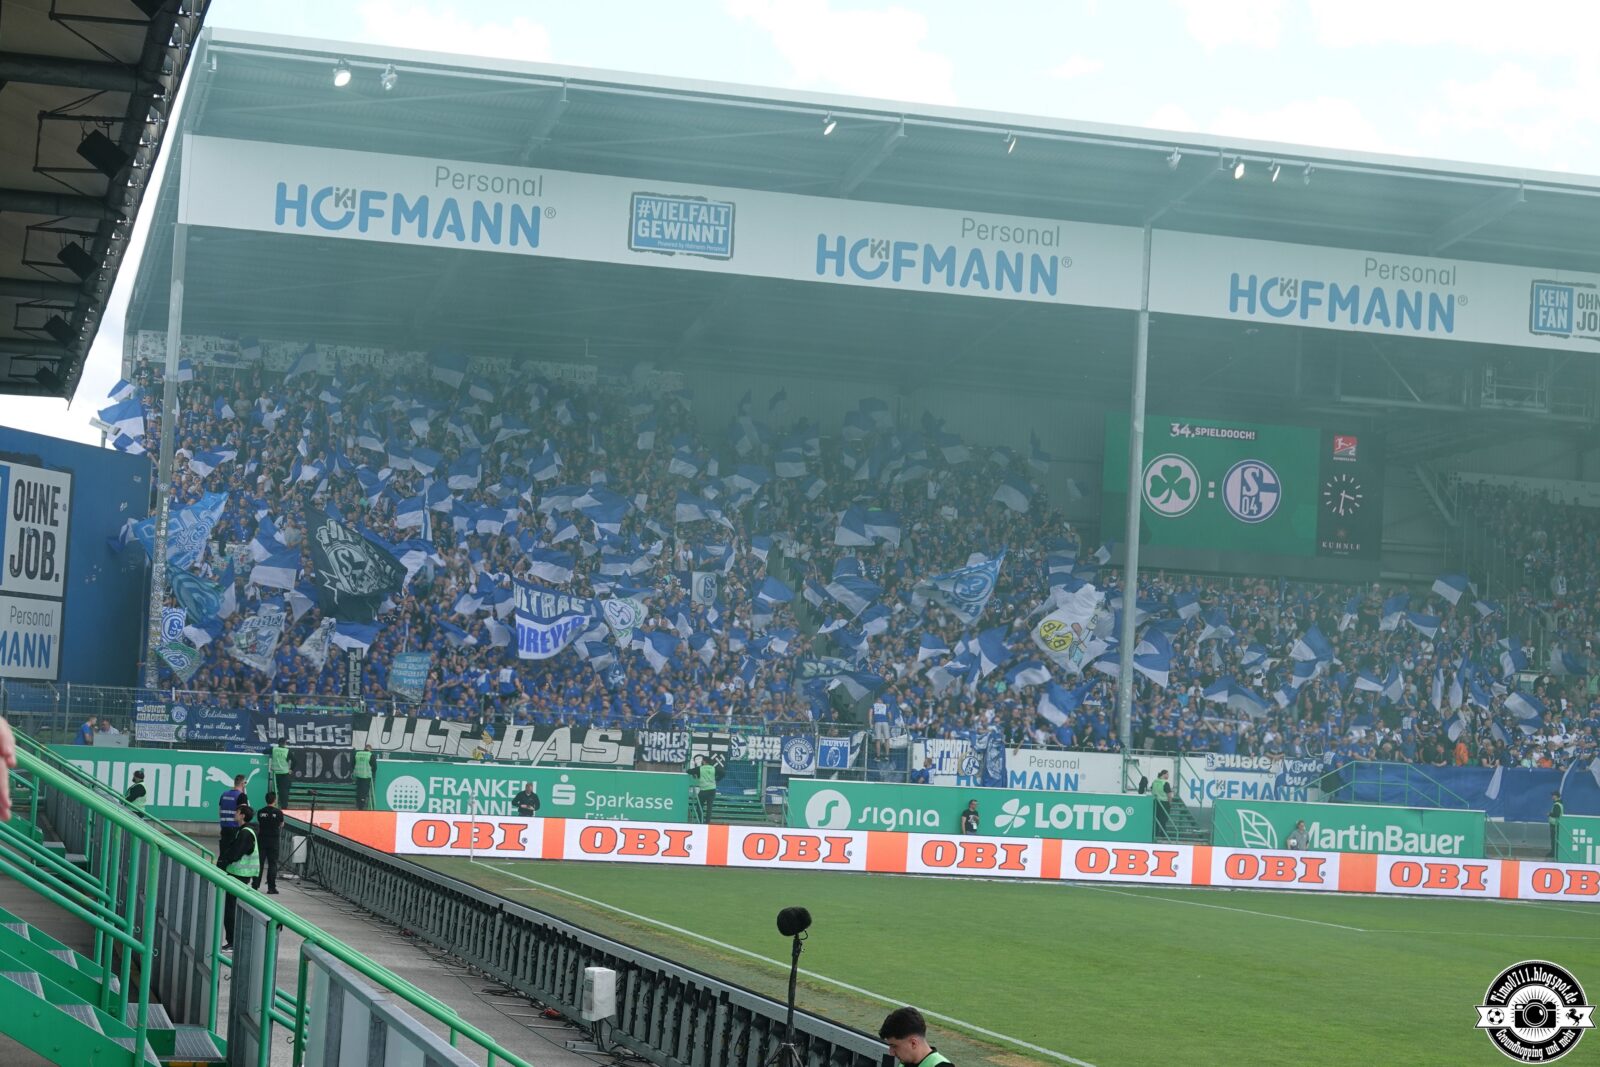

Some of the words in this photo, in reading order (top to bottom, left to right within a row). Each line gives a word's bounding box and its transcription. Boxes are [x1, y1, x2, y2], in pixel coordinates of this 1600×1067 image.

[434, 166, 544, 198] Personal
[637, 200, 728, 226] #VIELFALT
[637, 219, 727, 245] GEWINNT
[961, 217, 1061, 247] Personal
[1365, 257, 1457, 287] Personal
[1539, 288, 1568, 308] KEIN
[1538, 306, 1568, 329] FAN
[1195, 427, 1256, 440] SPIELDOOCH!
[13, 479, 61, 527] OHNE
[10, 527, 60, 583] JOB.
[10, 605, 54, 628] Personal
[638, 730, 690, 750] MARLER
[748, 735, 782, 748] BLUE
[748, 748, 782, 760] BOYZ
[642, 746, 687, 763] JUNGS
[1029, 755, 1080, 770] Personal
[584, 790, 674, 811] Sparkasse
[858, 805, 941, 832] signia
[1035, 802, 1127, 832] LOTTO
[411, 818, 528, 852] OBI
[578, 825, 693, 858] OBI
[741, 832, 853, 864] OBI
[921, 839, 1029, 871] OBI
[1074, 846, 1180, 878] OBI
[1224, 853, 1328, 884] OBI
[1389, 861, 1489, 891] OBI
